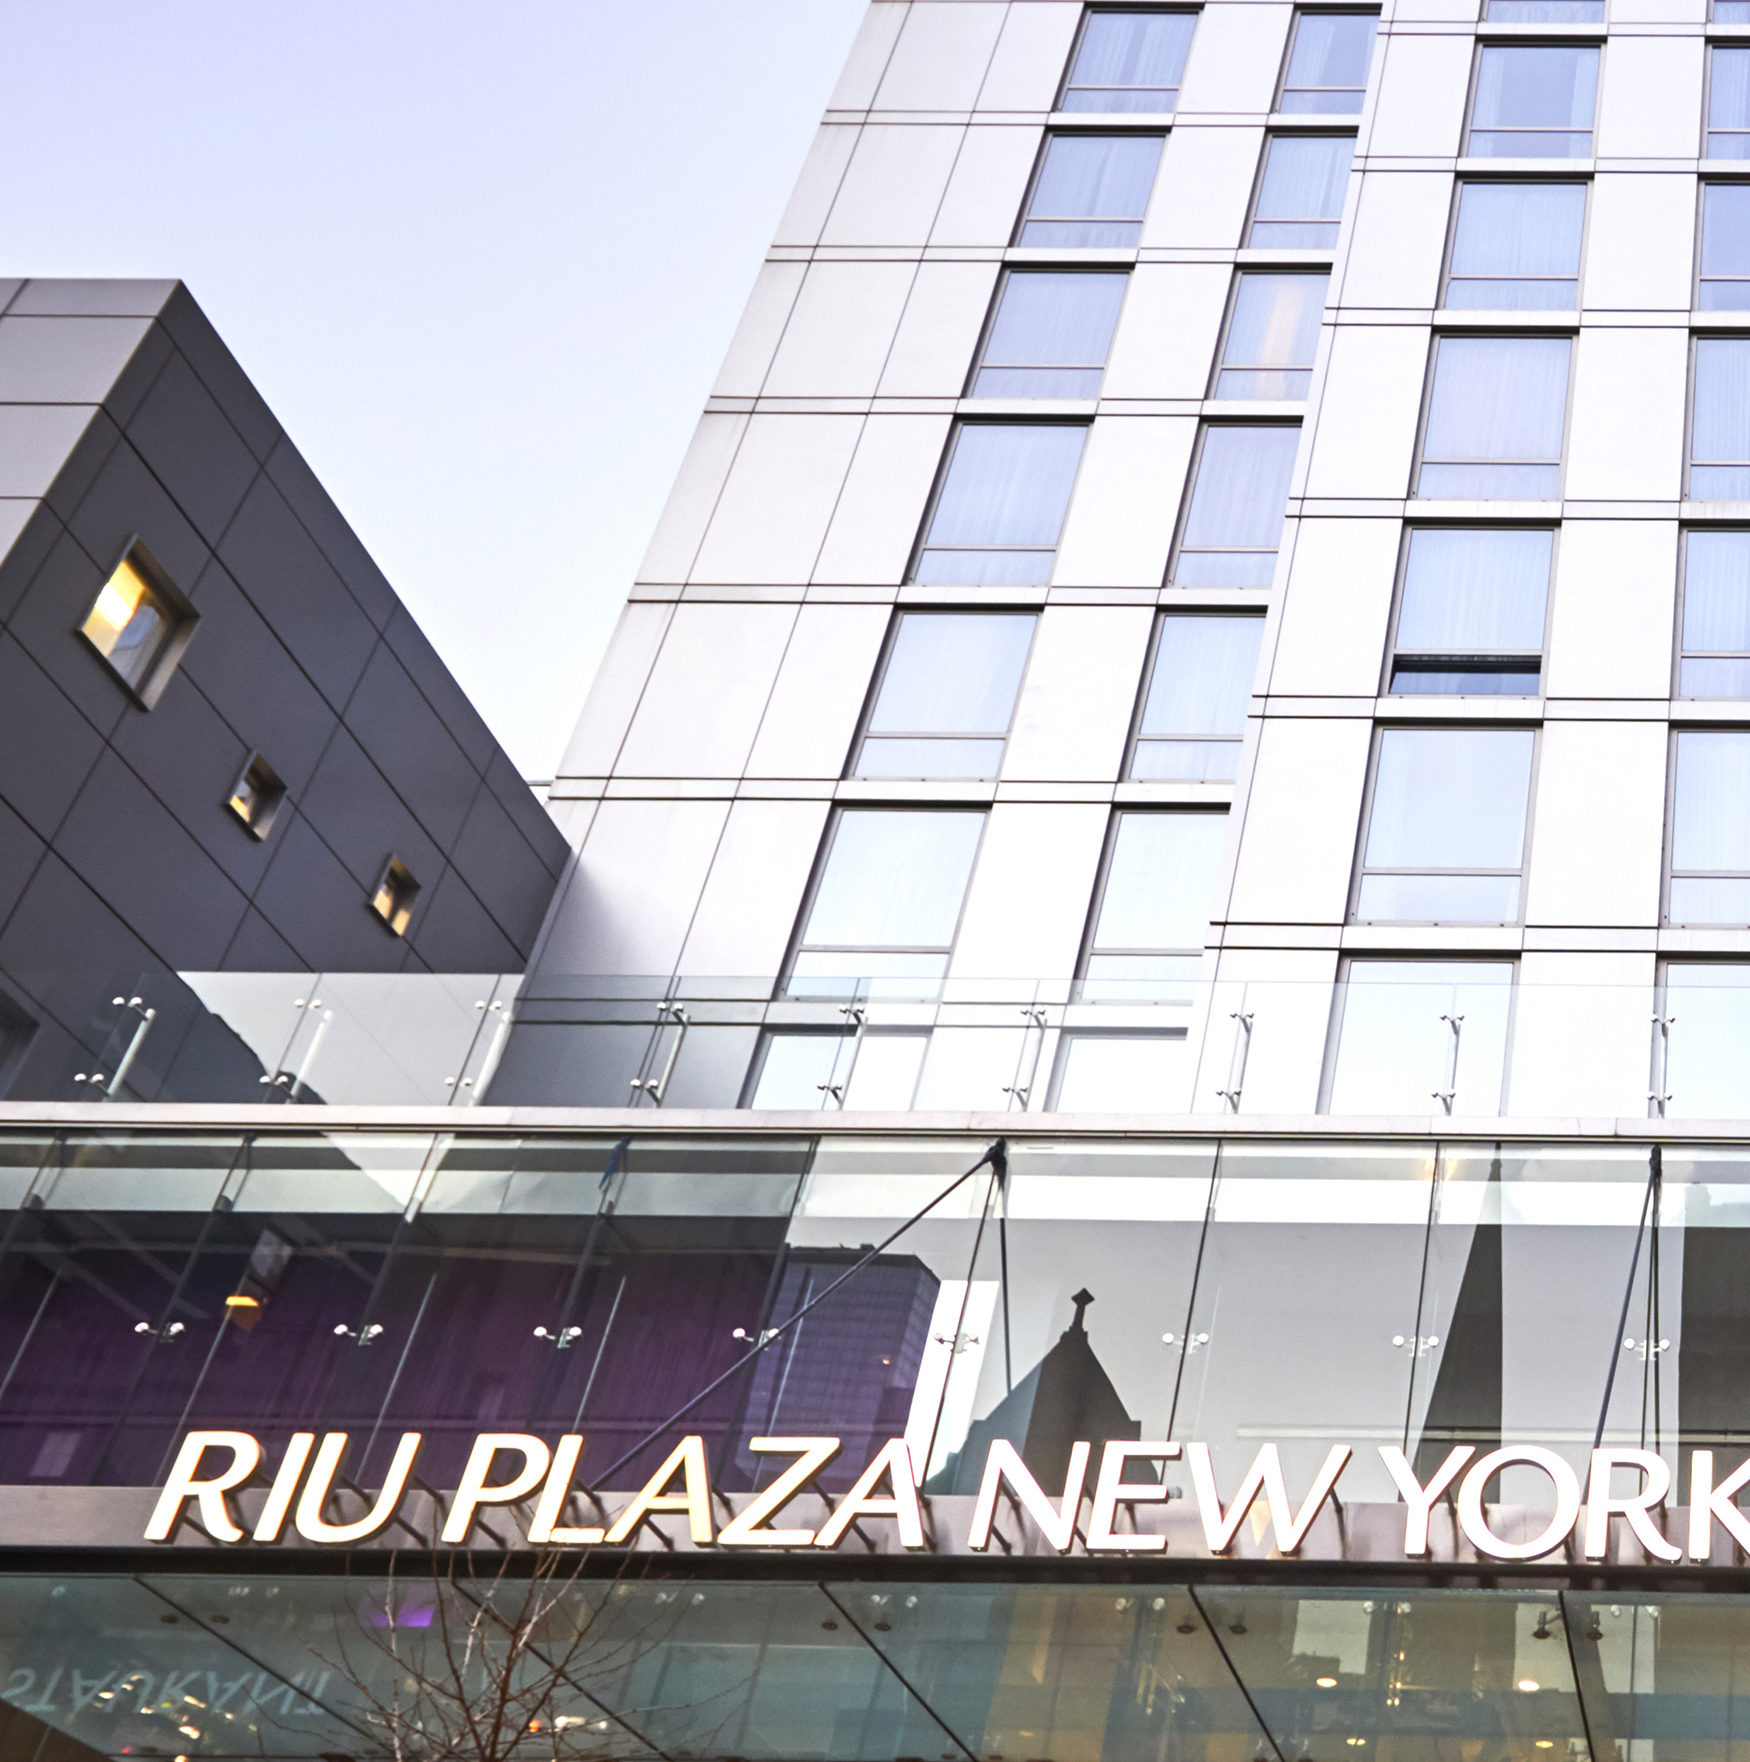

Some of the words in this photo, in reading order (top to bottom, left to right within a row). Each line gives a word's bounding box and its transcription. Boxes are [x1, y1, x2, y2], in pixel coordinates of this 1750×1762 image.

[144, 1430, 421, 1543] RIU
[441, 1433, 924, 1548] PLAZA
[968, 1439, 1352, 1553] NEW
